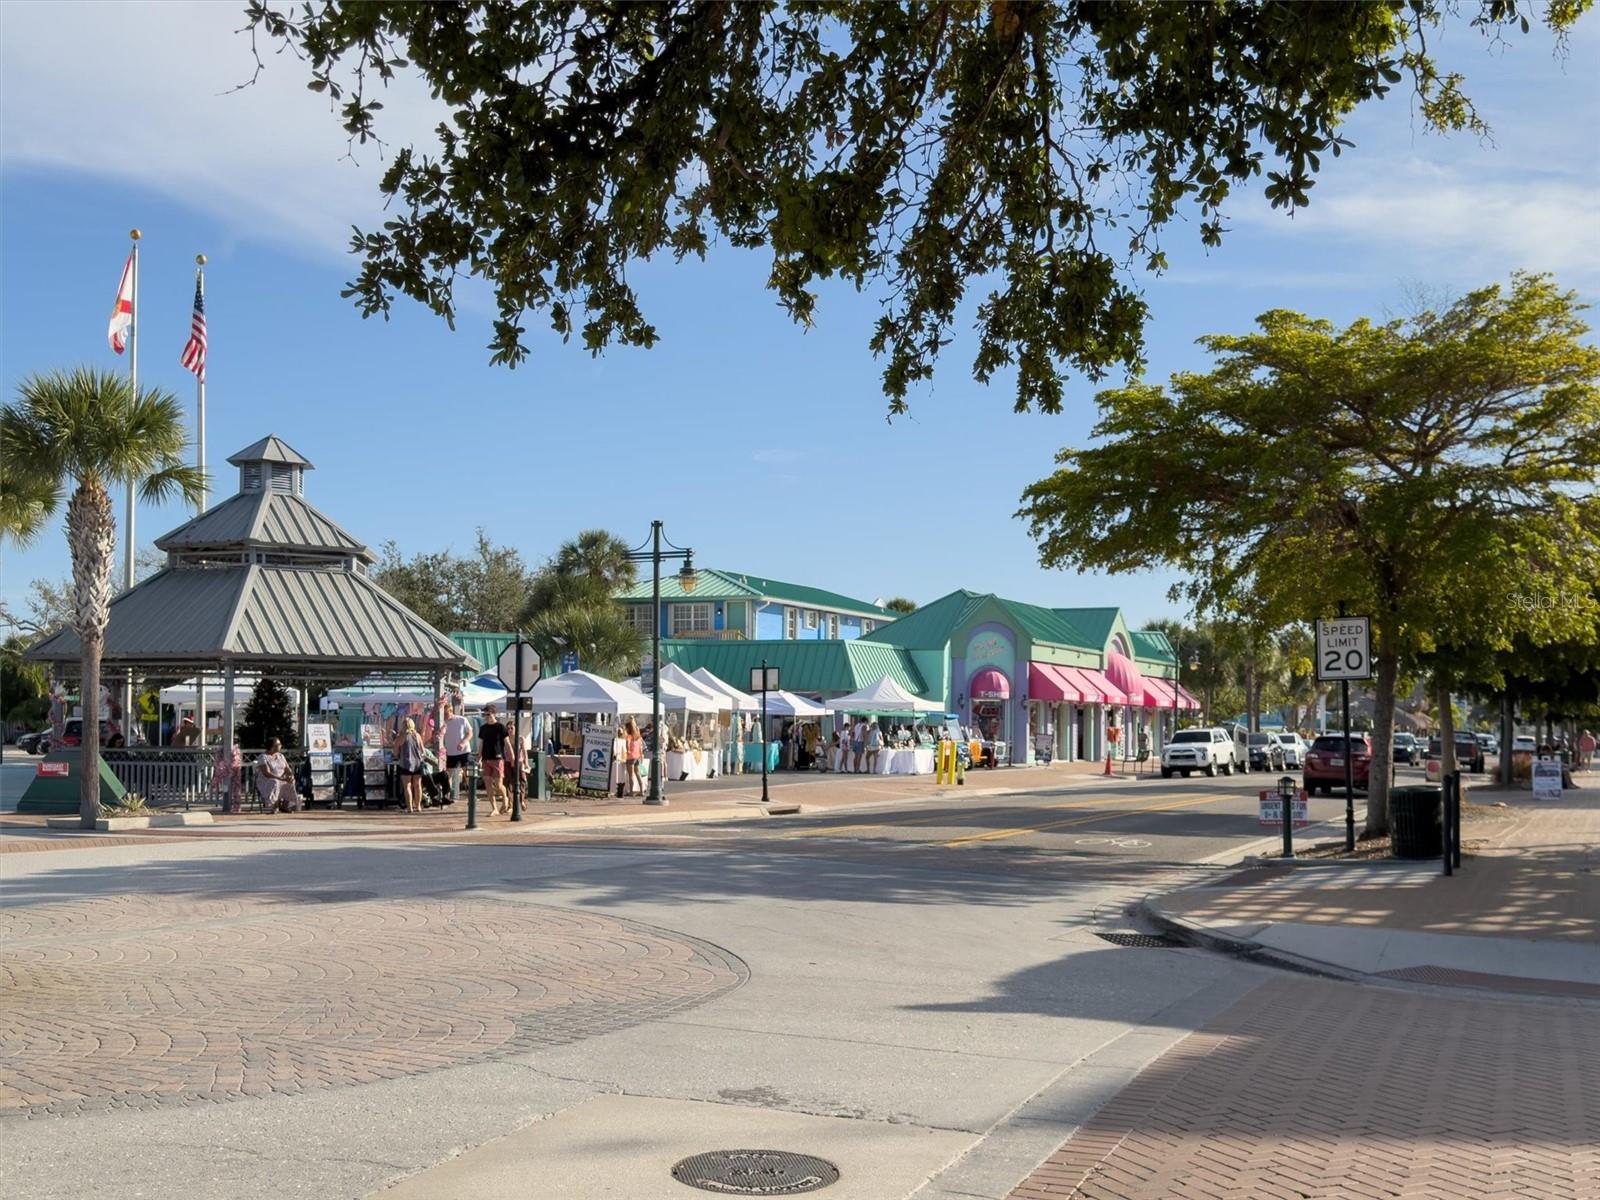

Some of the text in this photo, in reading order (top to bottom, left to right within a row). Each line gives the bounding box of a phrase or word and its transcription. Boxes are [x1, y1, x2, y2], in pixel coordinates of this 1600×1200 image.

[1322, 625, 1363, 636] SPEED
[1327, 637, 1359, 648] LIMIT
[1325, 649, 1363, 671] 20
[586, 739, 611, 747] PARKING
